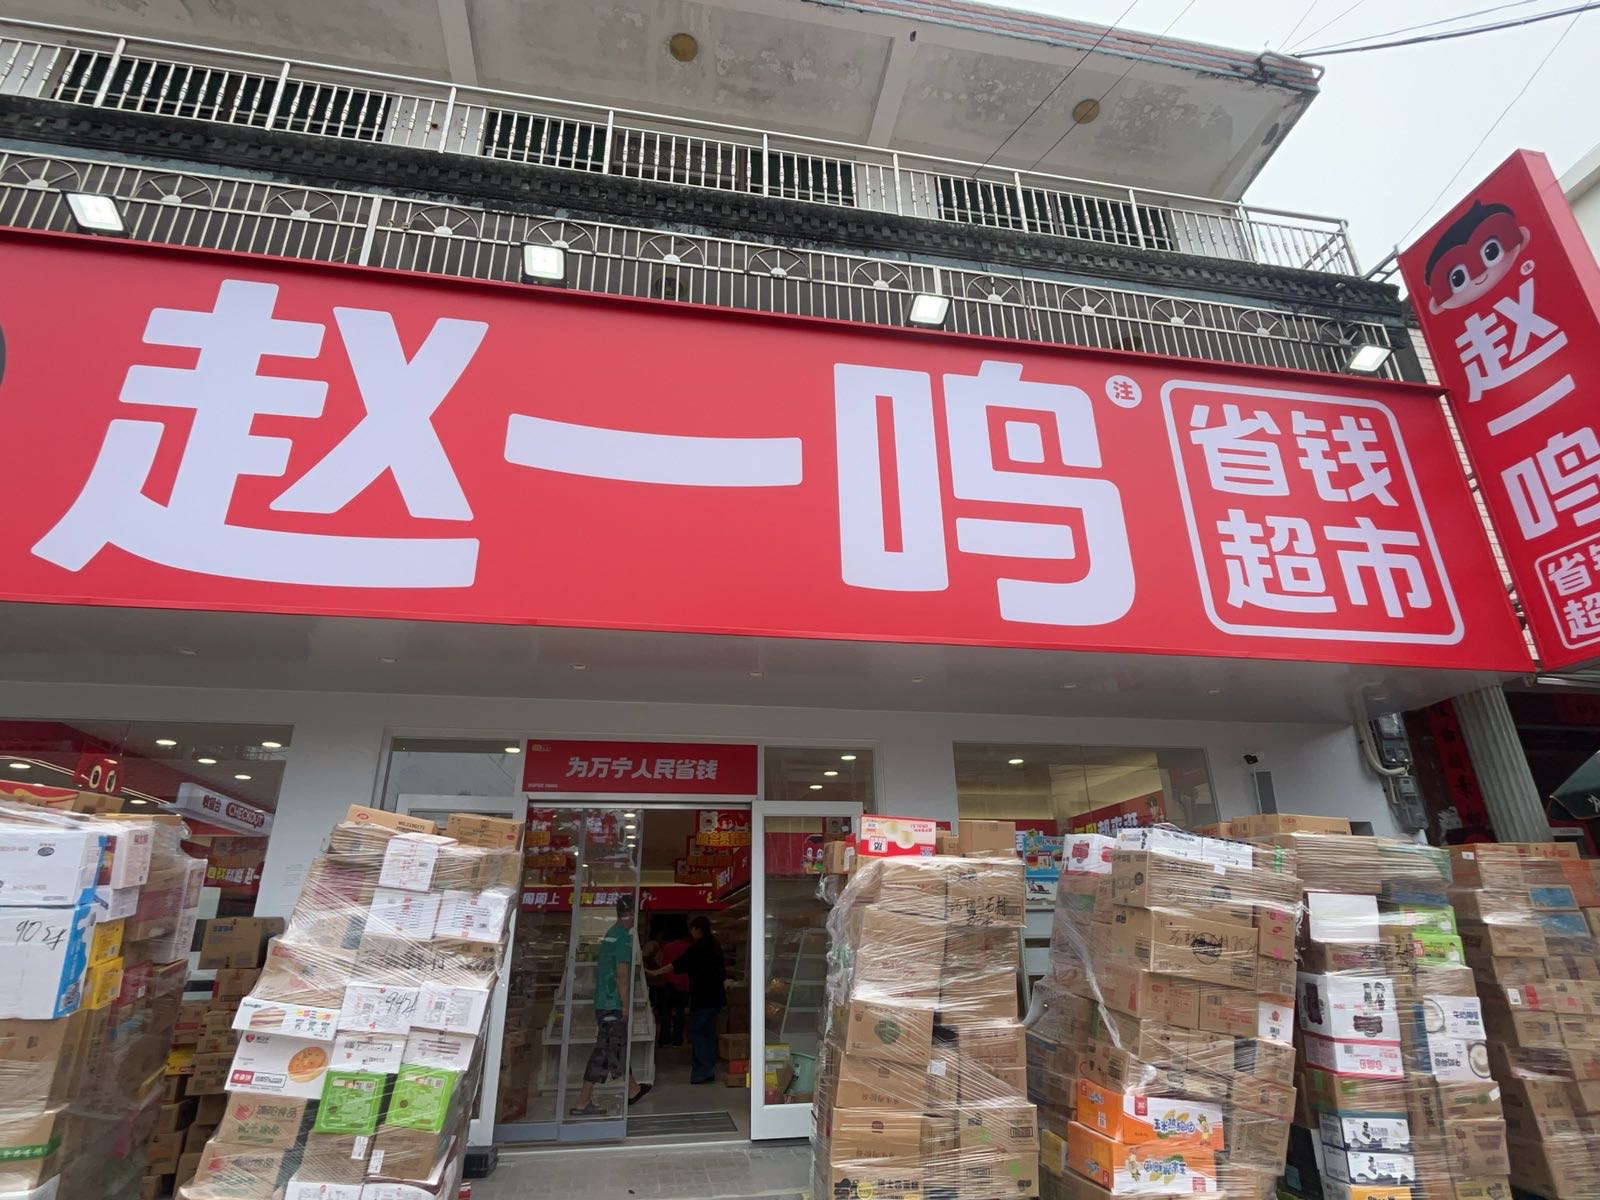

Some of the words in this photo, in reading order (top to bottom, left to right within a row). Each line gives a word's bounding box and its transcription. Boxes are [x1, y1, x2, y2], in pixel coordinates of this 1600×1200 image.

[1112, 380, 1136, 403] 注
[1457, 278, 1600, 540] 赵一鸣
[31, 279, 1136, 626] 赵一鸣
[1189, 403, 1399, 507] 省钱
[1216, 508, 1433, 618] 超市
[565, 756, 719, 781] 为万宁人民省钱
